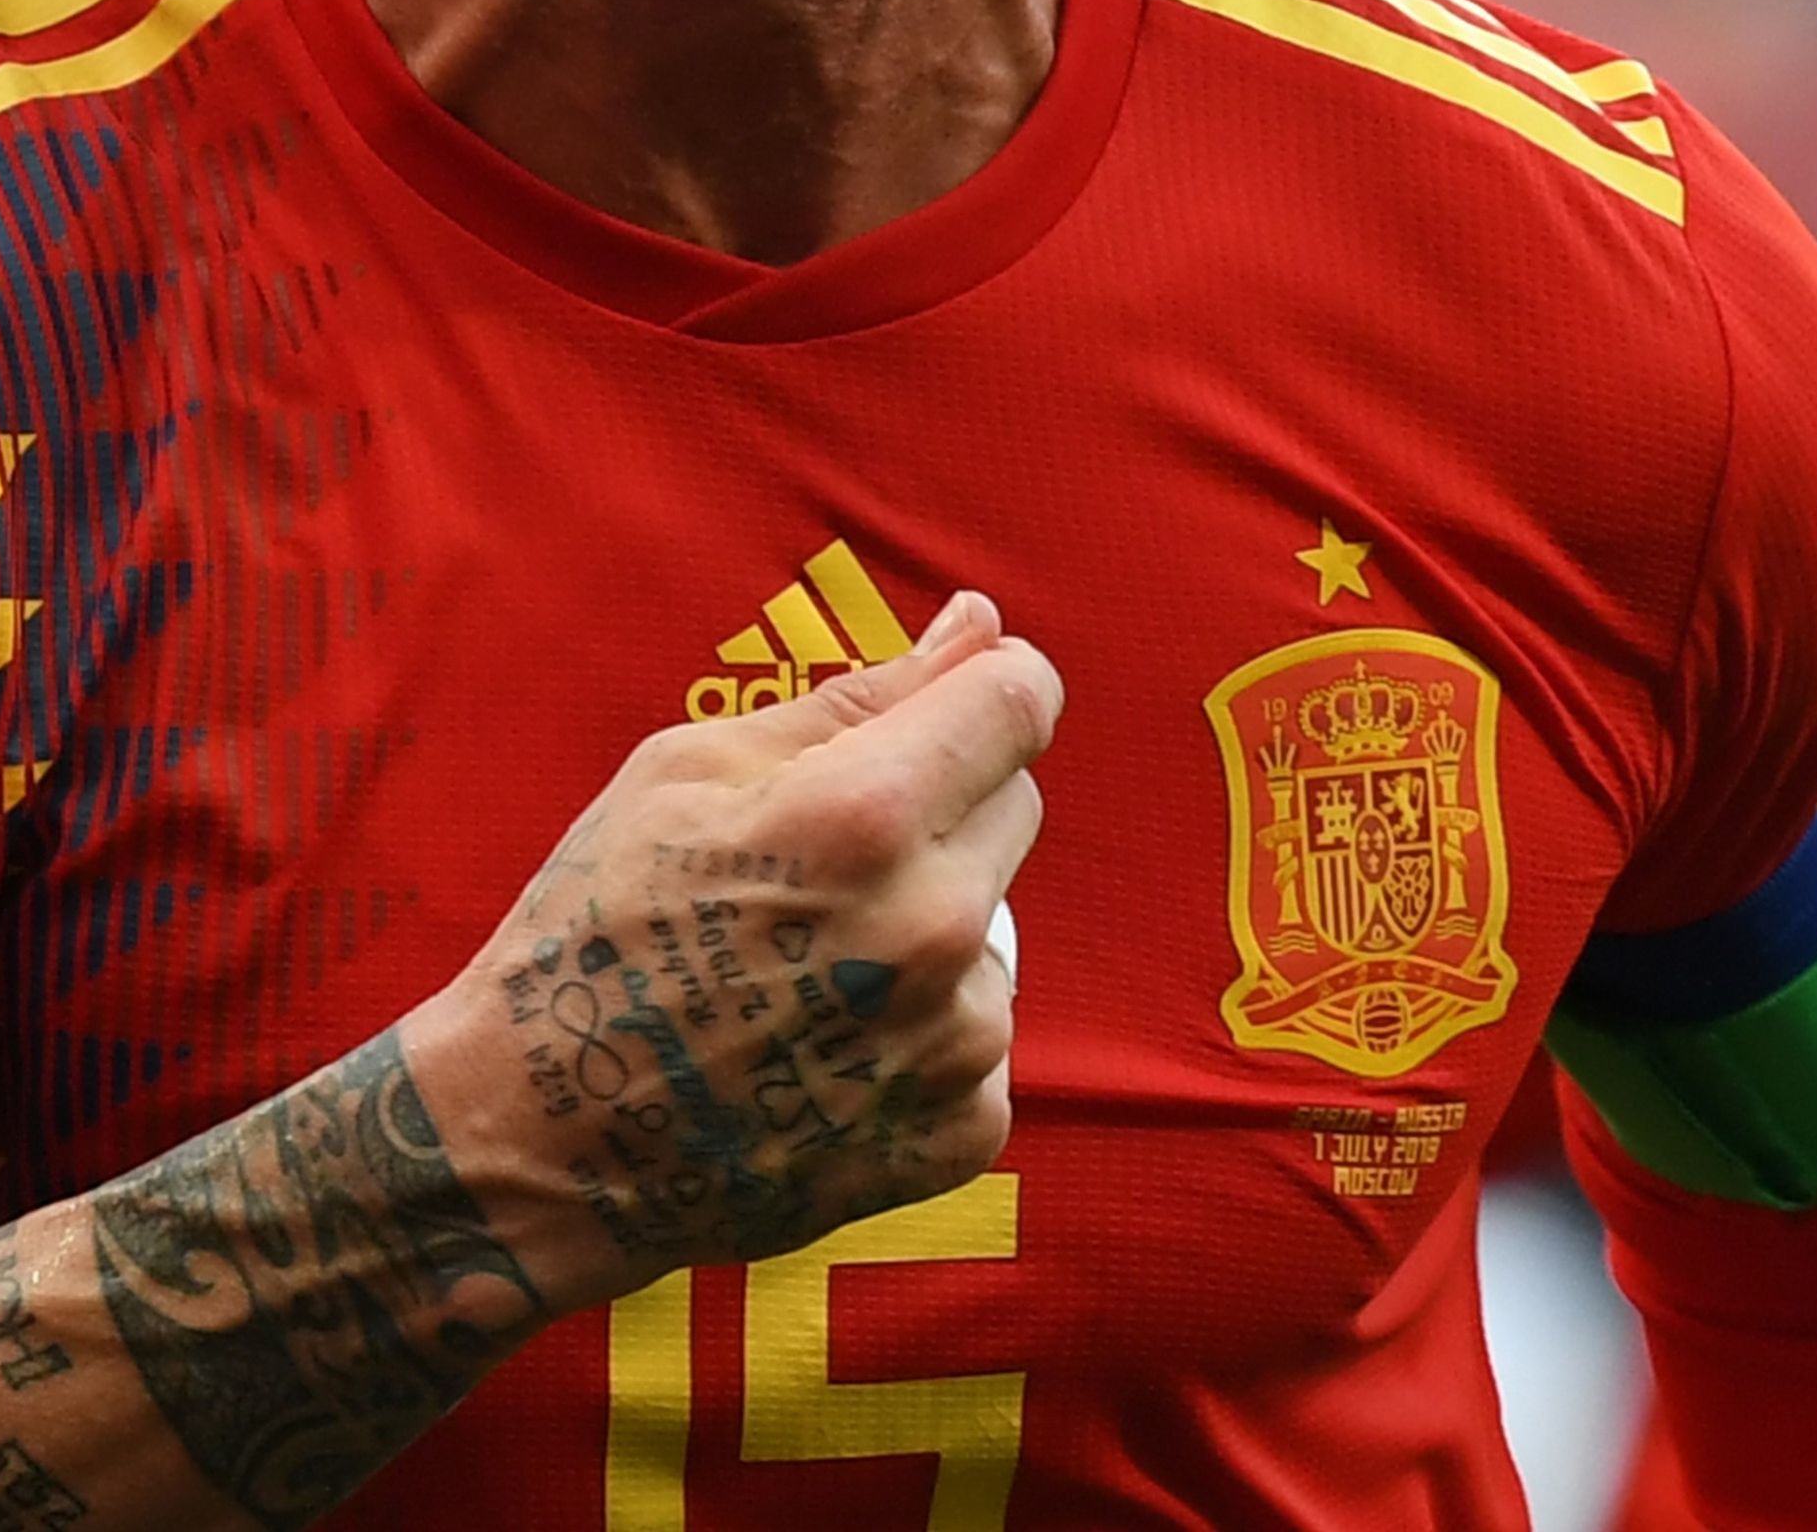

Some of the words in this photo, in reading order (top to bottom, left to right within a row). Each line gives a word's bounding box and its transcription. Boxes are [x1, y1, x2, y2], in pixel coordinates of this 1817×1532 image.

[686, 660, 863, 722] adi
[1262, 687, 1288, 722] 19
[1428, 681, 1455, 707] 09
[1394, 1102, 1467, 1133] RUSSIA
[1313, 1132, 1325, 1161] 1
[1331, 1133, 1388, 1164] JULY
[1334, 1166, 1419, 1196] MOSCOW
[604, 1172, 1026, 1532] 15
